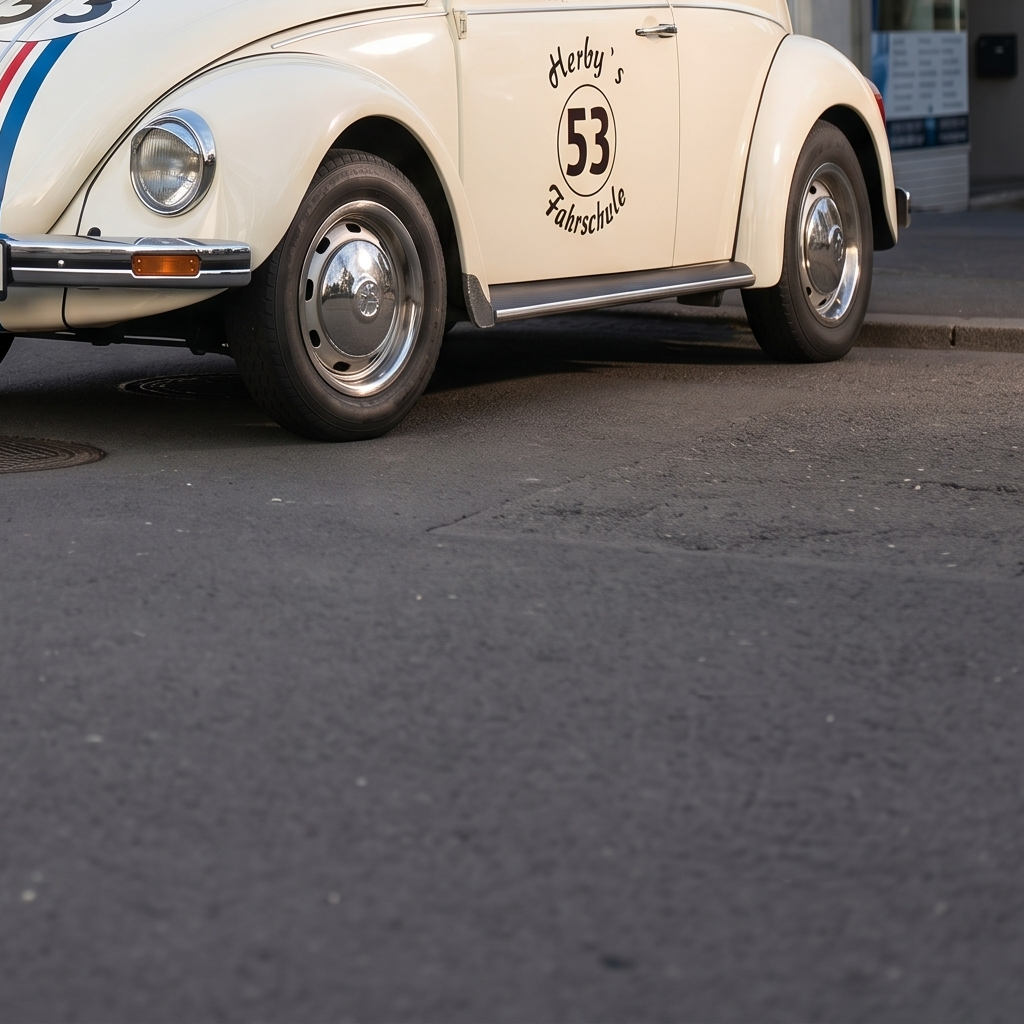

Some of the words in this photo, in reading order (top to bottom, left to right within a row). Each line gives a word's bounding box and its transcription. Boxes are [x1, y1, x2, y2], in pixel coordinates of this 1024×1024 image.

[548, 36, 625, 89] Herby's
[565, 106, 611, 177] 53
[545, 184, 627, 236] Fahrschule
